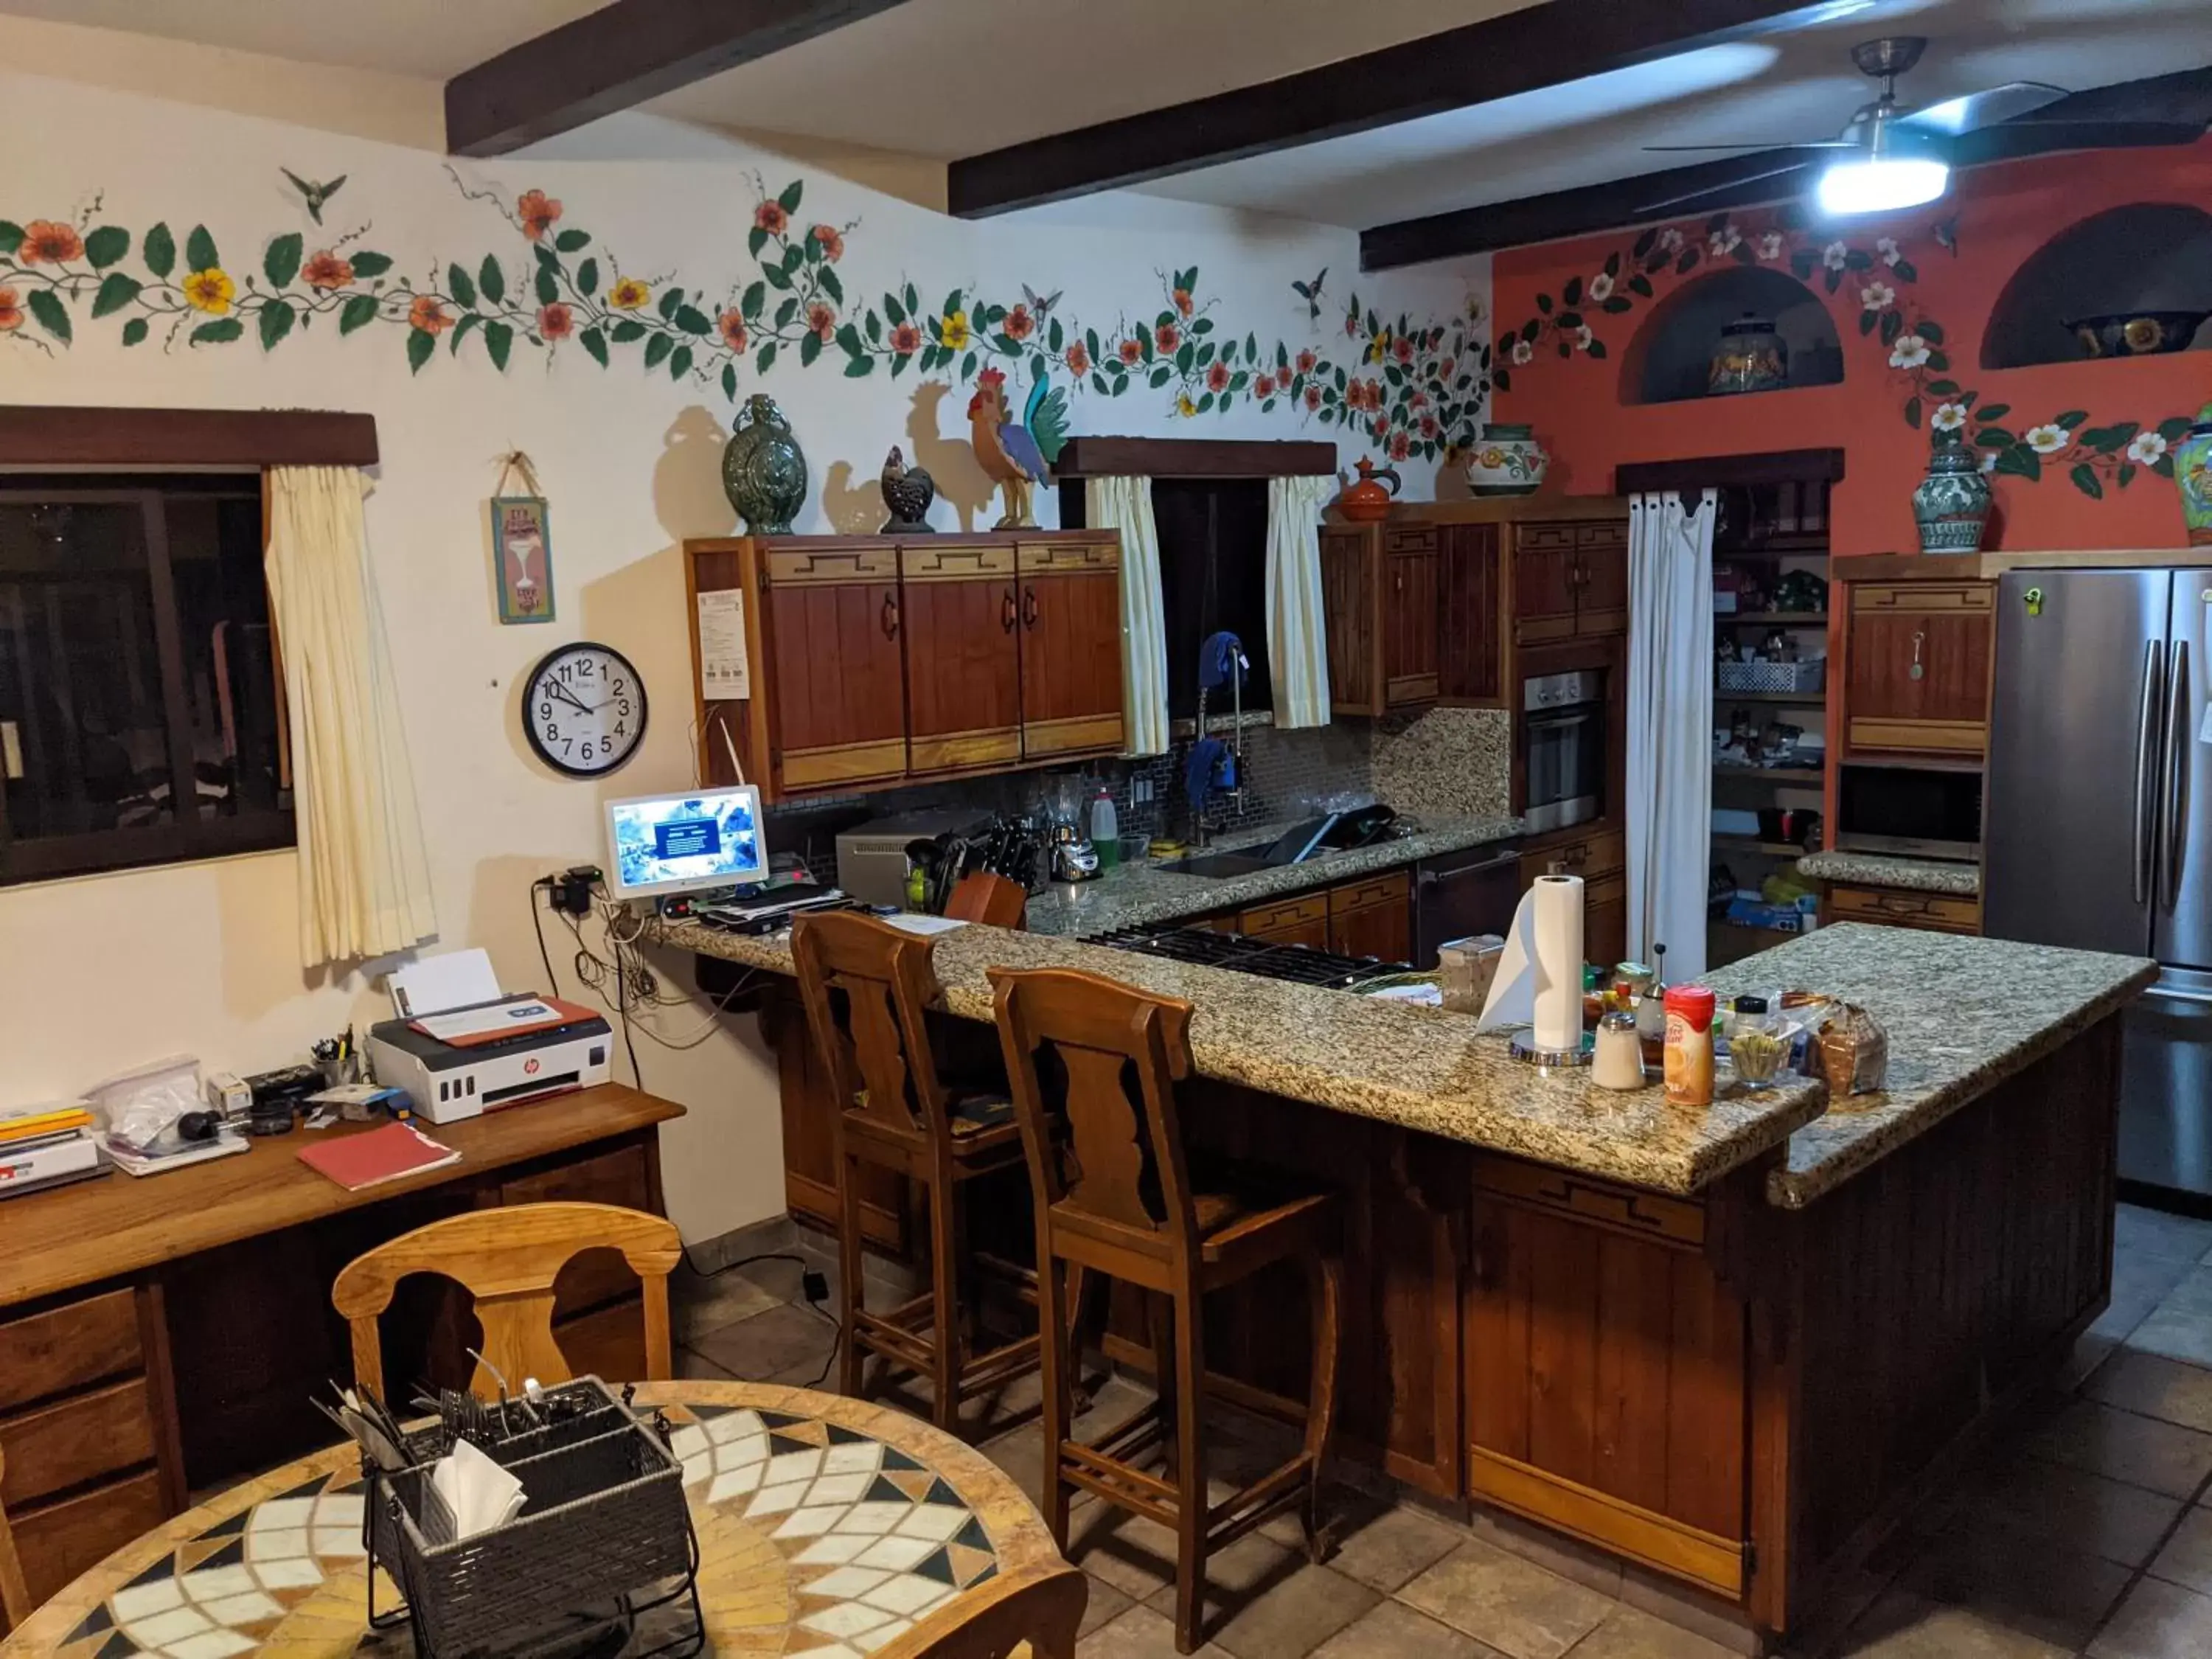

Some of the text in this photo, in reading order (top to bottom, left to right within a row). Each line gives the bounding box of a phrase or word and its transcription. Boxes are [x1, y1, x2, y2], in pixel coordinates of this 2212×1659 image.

[559, 665, 571, 682] 11
[574, 658, 593, 676] 12
[599, 664, 608, 681] 1
[542, 681, 560, 699] 10
[613, 679, 624, 696] 2
[540, 703, 552, 720] 9
[618, 699, 630, 716] 3
[547, 723, 558, 741] 8
[613, 720, 625, 737] 4
[562, 738, 573, 755] 7
[581, 742, 593, 760] 6
[601, 735, 612, 753] 5
